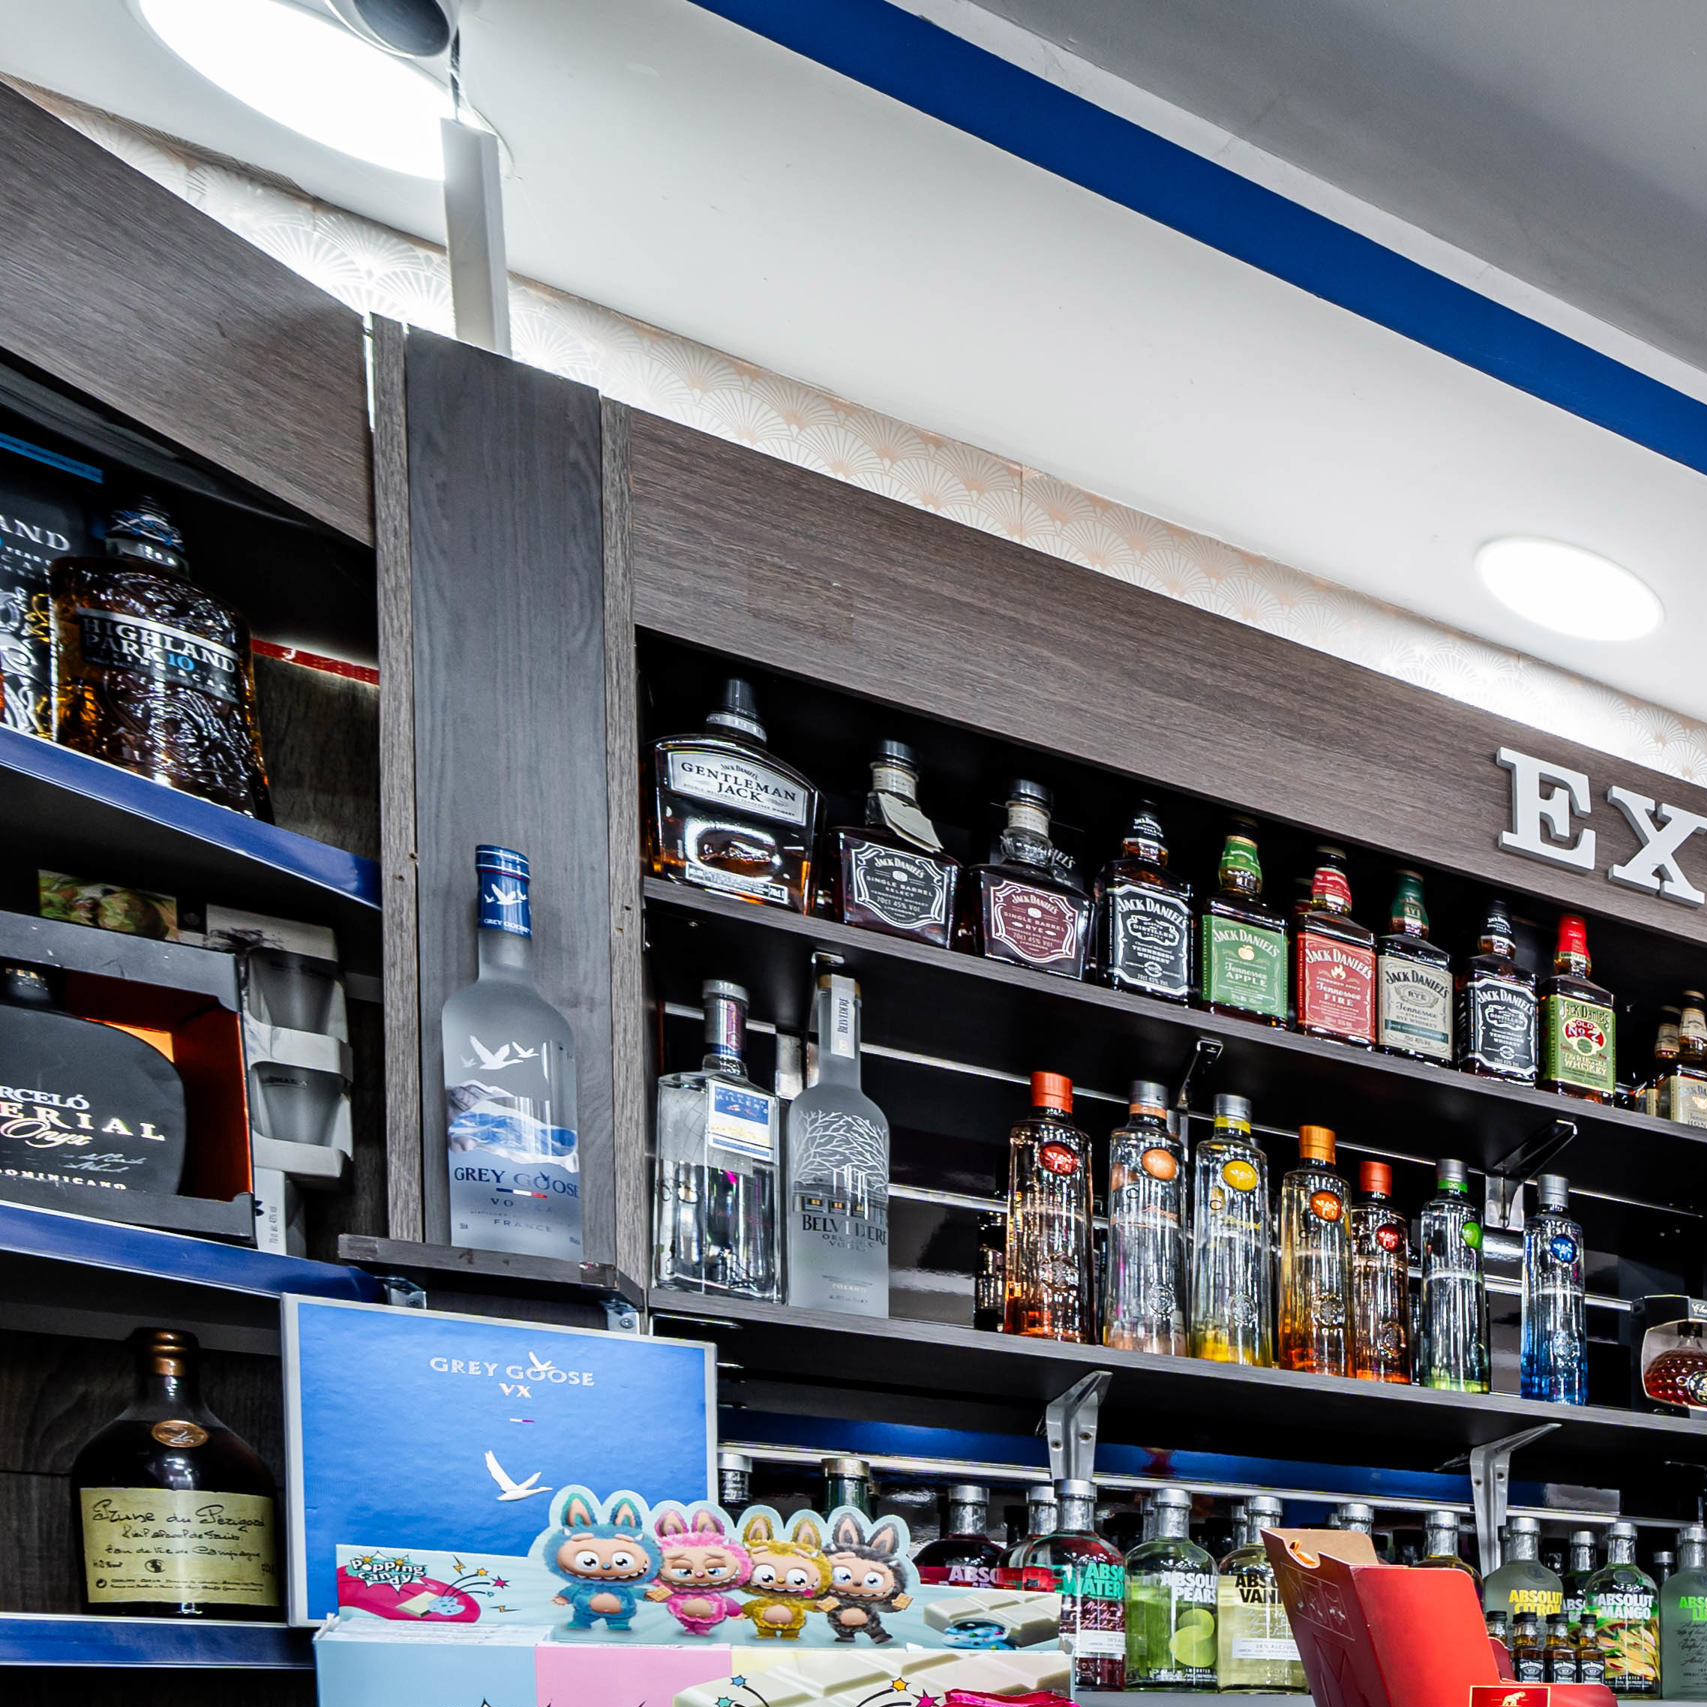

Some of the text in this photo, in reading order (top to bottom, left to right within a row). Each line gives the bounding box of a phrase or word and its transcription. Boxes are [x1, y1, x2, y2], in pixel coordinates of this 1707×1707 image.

[83, 617, 237, 674] HIGHLAND
[84, 635, 195, 671] PARK 10
[681, 762, 797, 802] GENTLEMAN
[718, 782, 763, 803] JACK
[874, 856, 894, 868] JACK
[866, 875, 934, 898] SINGLE BARREL
[1011, 892, 1030, 905] JACK
[1003, 910, 1066, 933] SINGLE BARREL
[1117, 897, 1189, 928] JACK DANIEL'S
[1025, 923, 1045, 934] RYE
[1212, 928, 1281, 958] JACK DANIEL'S
[1305, 948, 1373, 980] JACK DANIEL'S
[1225, 971, 1269, 987] APPLE
[1385, 969, 1450, 999] JACK DANIEL'S
[1324, 994, 1354, 1007] FIRE
[1477, 988, 1536, 1016] JACK DANIEL'S
[0, 1118, 94, 1149] Onyx
[454, 1166, 581, 1199] GREY GOOSE
[429, 1356, 596, 1387] GREY GOOSE
[498, 1382, 533, 1399] VX
[166, 1512, 193, 1524] du
[1174, 1587, 1217, 1603] PEARS
[1508, 1589, 1563, 1606] ABSOLUT
[1597, 1593, 1655, 1608] ABSOLUT
[1600, 1605, 1651, 1621] MANGO
